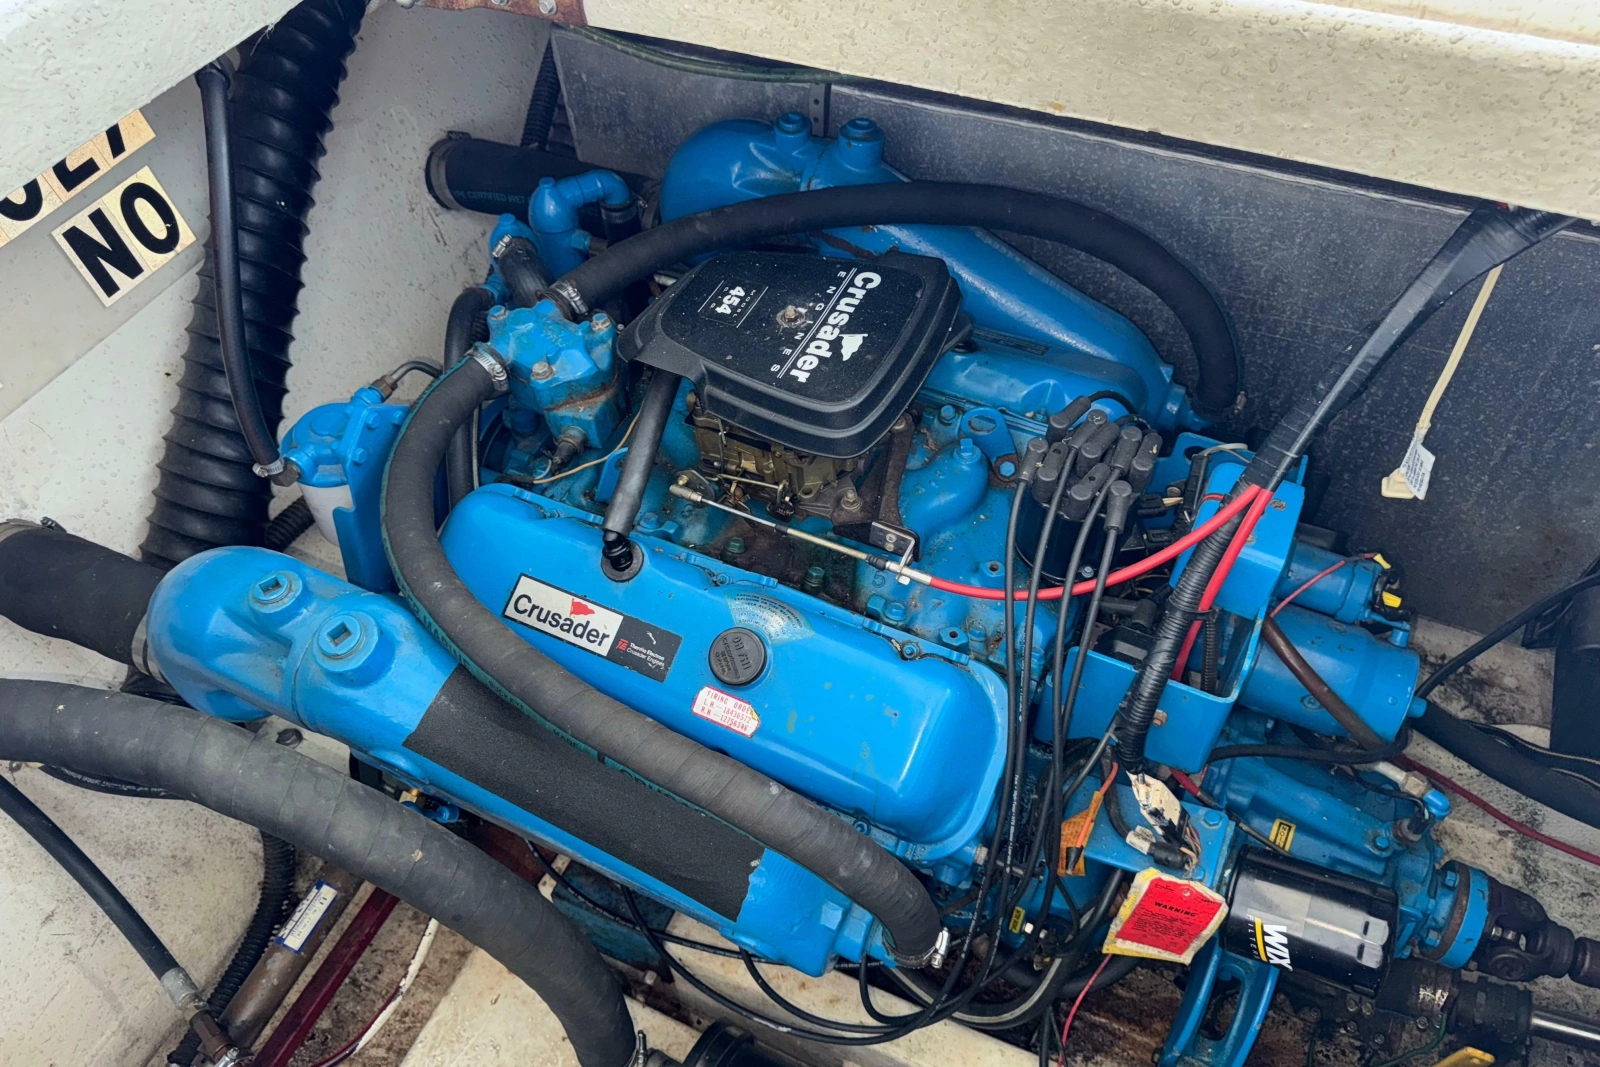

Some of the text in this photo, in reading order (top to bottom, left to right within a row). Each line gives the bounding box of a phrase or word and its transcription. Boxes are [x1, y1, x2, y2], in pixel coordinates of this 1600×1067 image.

[62, 182, 180, 298] NO
[715, 286, 746, 315] 454
[770, 270, 847, 373] ENGINES
[789, 271, 882, 383] Crusader
[513, 593, 610, 647] Crusader
[627, 647, 647, 660] Crusader
[647, 649, 665, 661] Electron
[732, 636, 753, 671] Oil Fill
[706, 690, 729, 705] FIRING
[1154, 901, 1197, 918] WARNING
[1245, 913, 1261, 960] FILTERS
[1263, 924, 1294, 972] WIX
